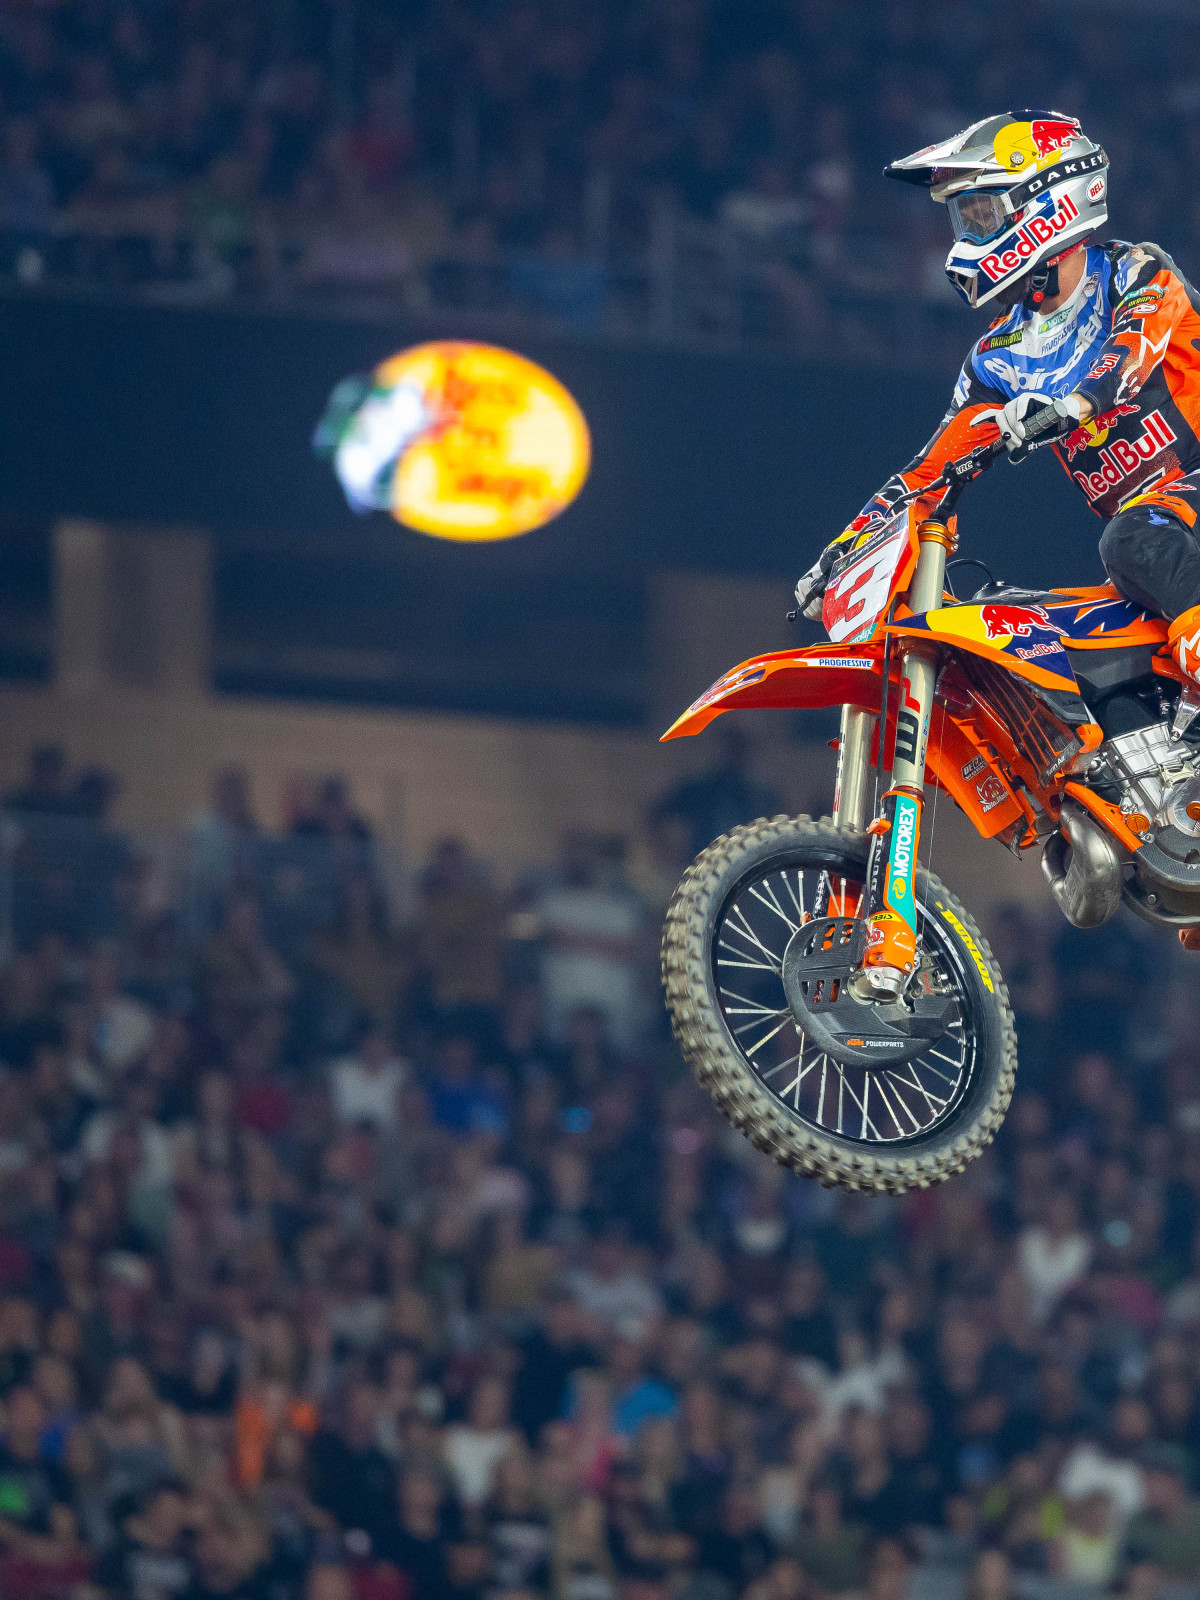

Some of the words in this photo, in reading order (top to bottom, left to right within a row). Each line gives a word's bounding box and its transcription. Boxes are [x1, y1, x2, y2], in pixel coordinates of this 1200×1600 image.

[1028, 155, 1103, 192] OAKLEY
[1089, 181, 1104, 197] BELL
[979, 229, 1037, 281] Red
[1028, 194, 1079, 244] Bull
[1110, 411, 1175, 475] Bull
[819, 658, 873, 668] PROGRESSIVE
[1016, 645, 1042, 659] Red
[1039, 641, 1065, 655] Bull
[893, 805, 915, 878] MOTOREX
